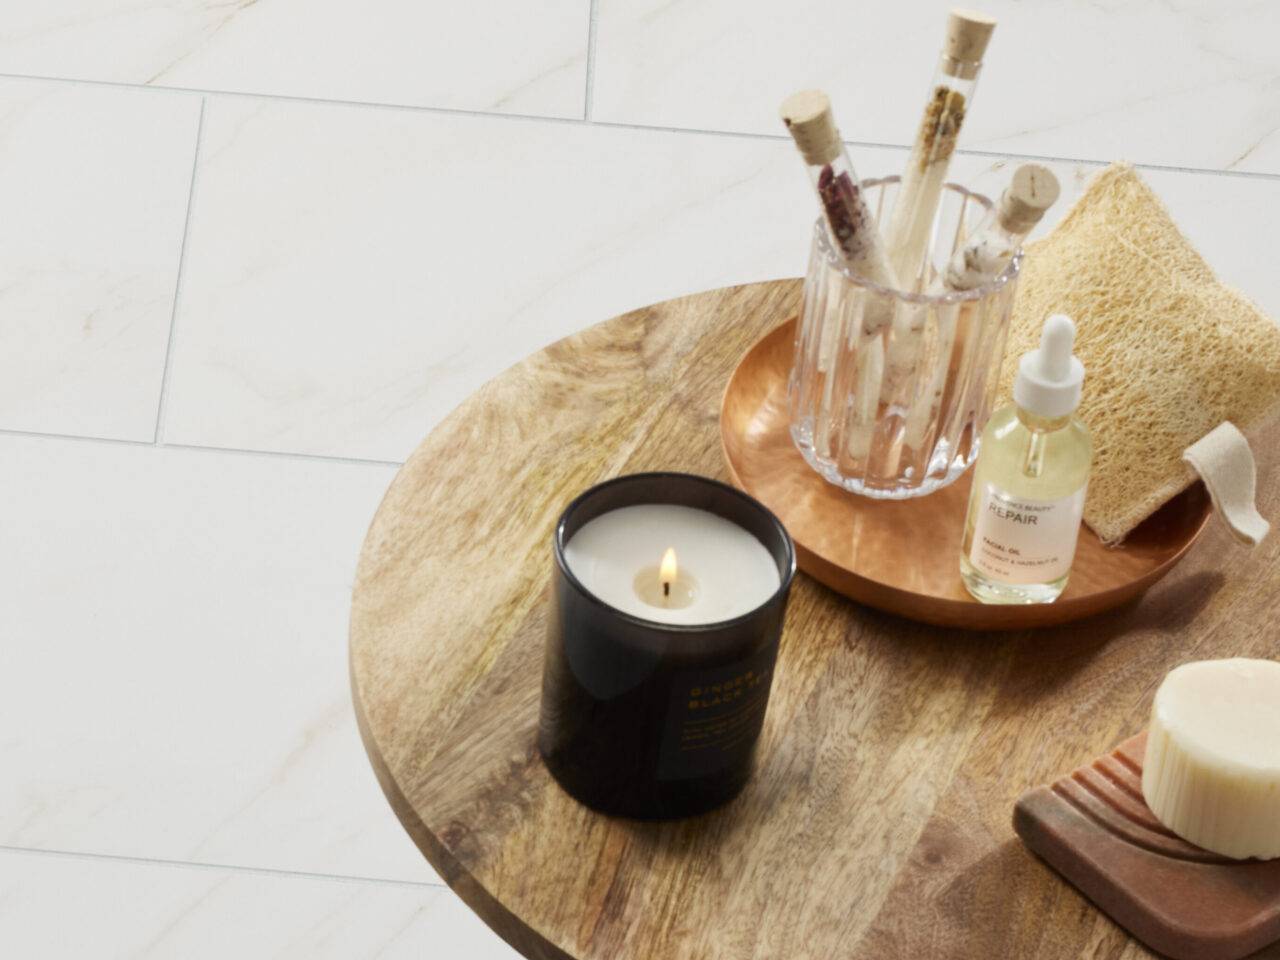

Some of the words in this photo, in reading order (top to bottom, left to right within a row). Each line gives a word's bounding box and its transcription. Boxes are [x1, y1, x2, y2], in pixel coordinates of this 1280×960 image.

[988, 502, 1039, 526] REPAIR
[983, 537, 1005, 552] FACIAL
[1008, 548, 1021, 556] OIL
[690, 671, 753, 697] GINGER
[688, 688, 743, 710] BLACK
